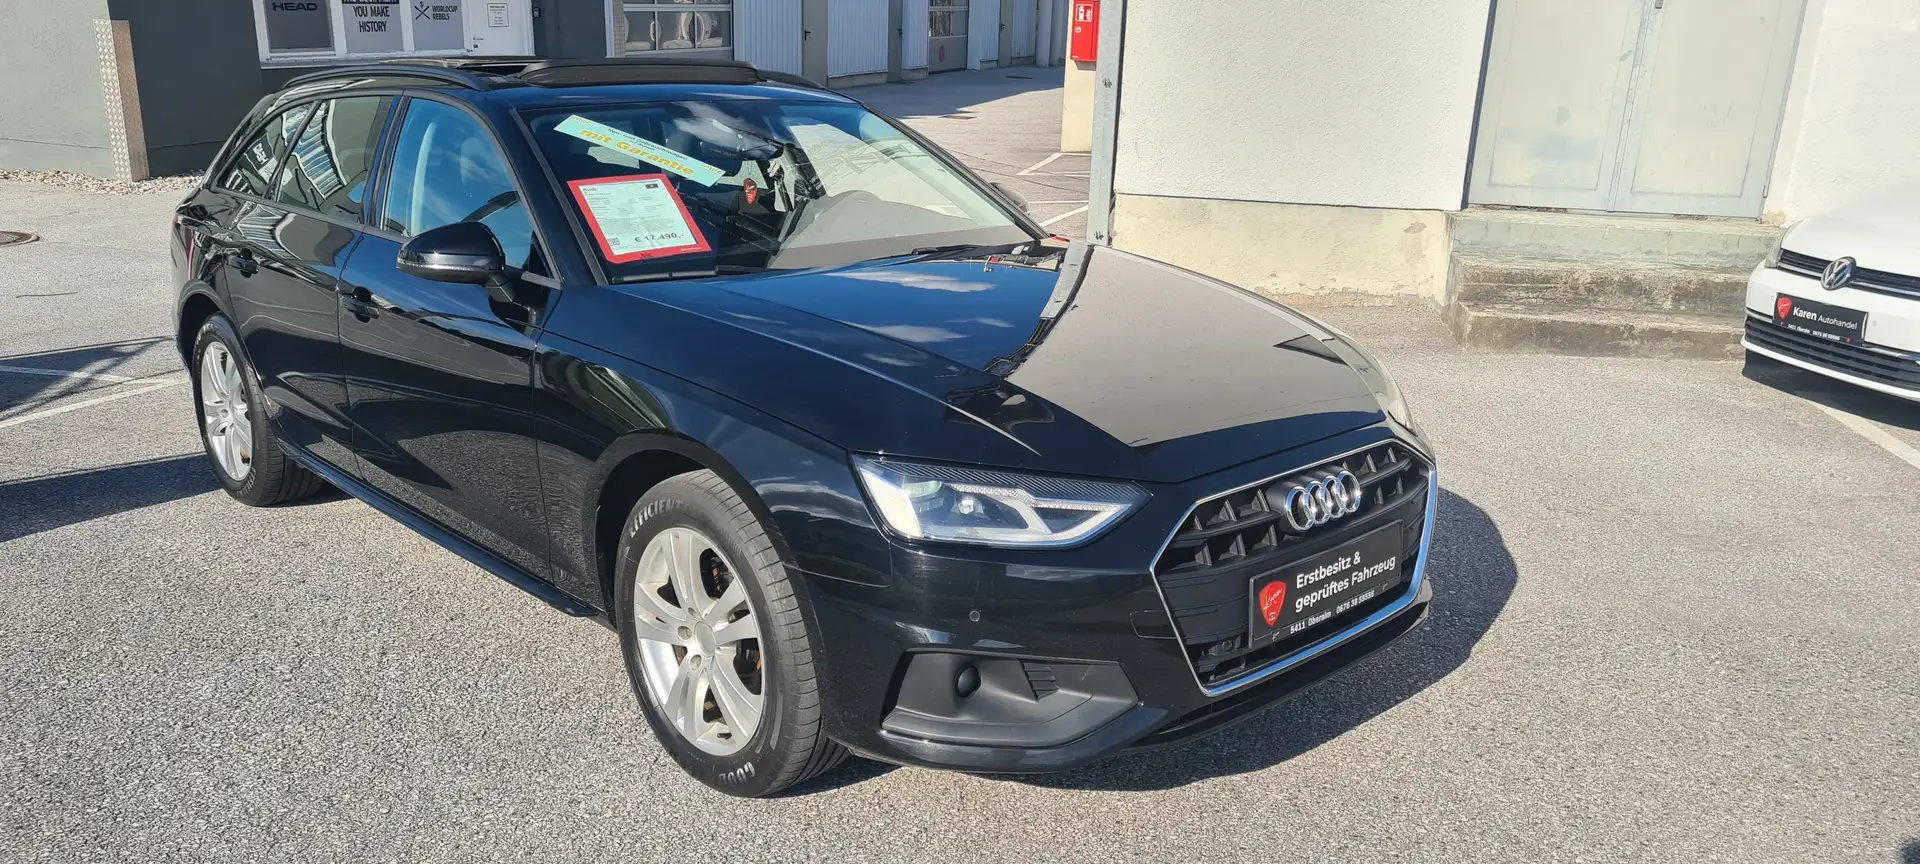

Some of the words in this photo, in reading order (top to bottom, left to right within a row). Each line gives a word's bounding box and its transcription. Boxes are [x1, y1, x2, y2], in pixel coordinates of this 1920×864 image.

[272, 2, 318, 11] HEAD
[352, 6, 368, 17] YOU
[370, 6, 390, 17] MAKE
[431, 5, 458, 13] WORLDCUP
[358, 20, 387, 32] HISTORY
[580, 129, 612, 143] mit
[616, 141, 694, 175] Garantie
[1793, 306, 1817, 321] Karen
[1818, 315, 1858, 330] Autohandel
[1296, 557, 1352, 589] Erstbesitz
[1353, 551, 1361, 565] &
[1295, 578, 1350, 613] geprüftes
[1351, 556, 1396, 586] Fahrzeug
[1290, 621, 1306, 634] 5411
[1307, 611, 1332, 627] Oberalm
